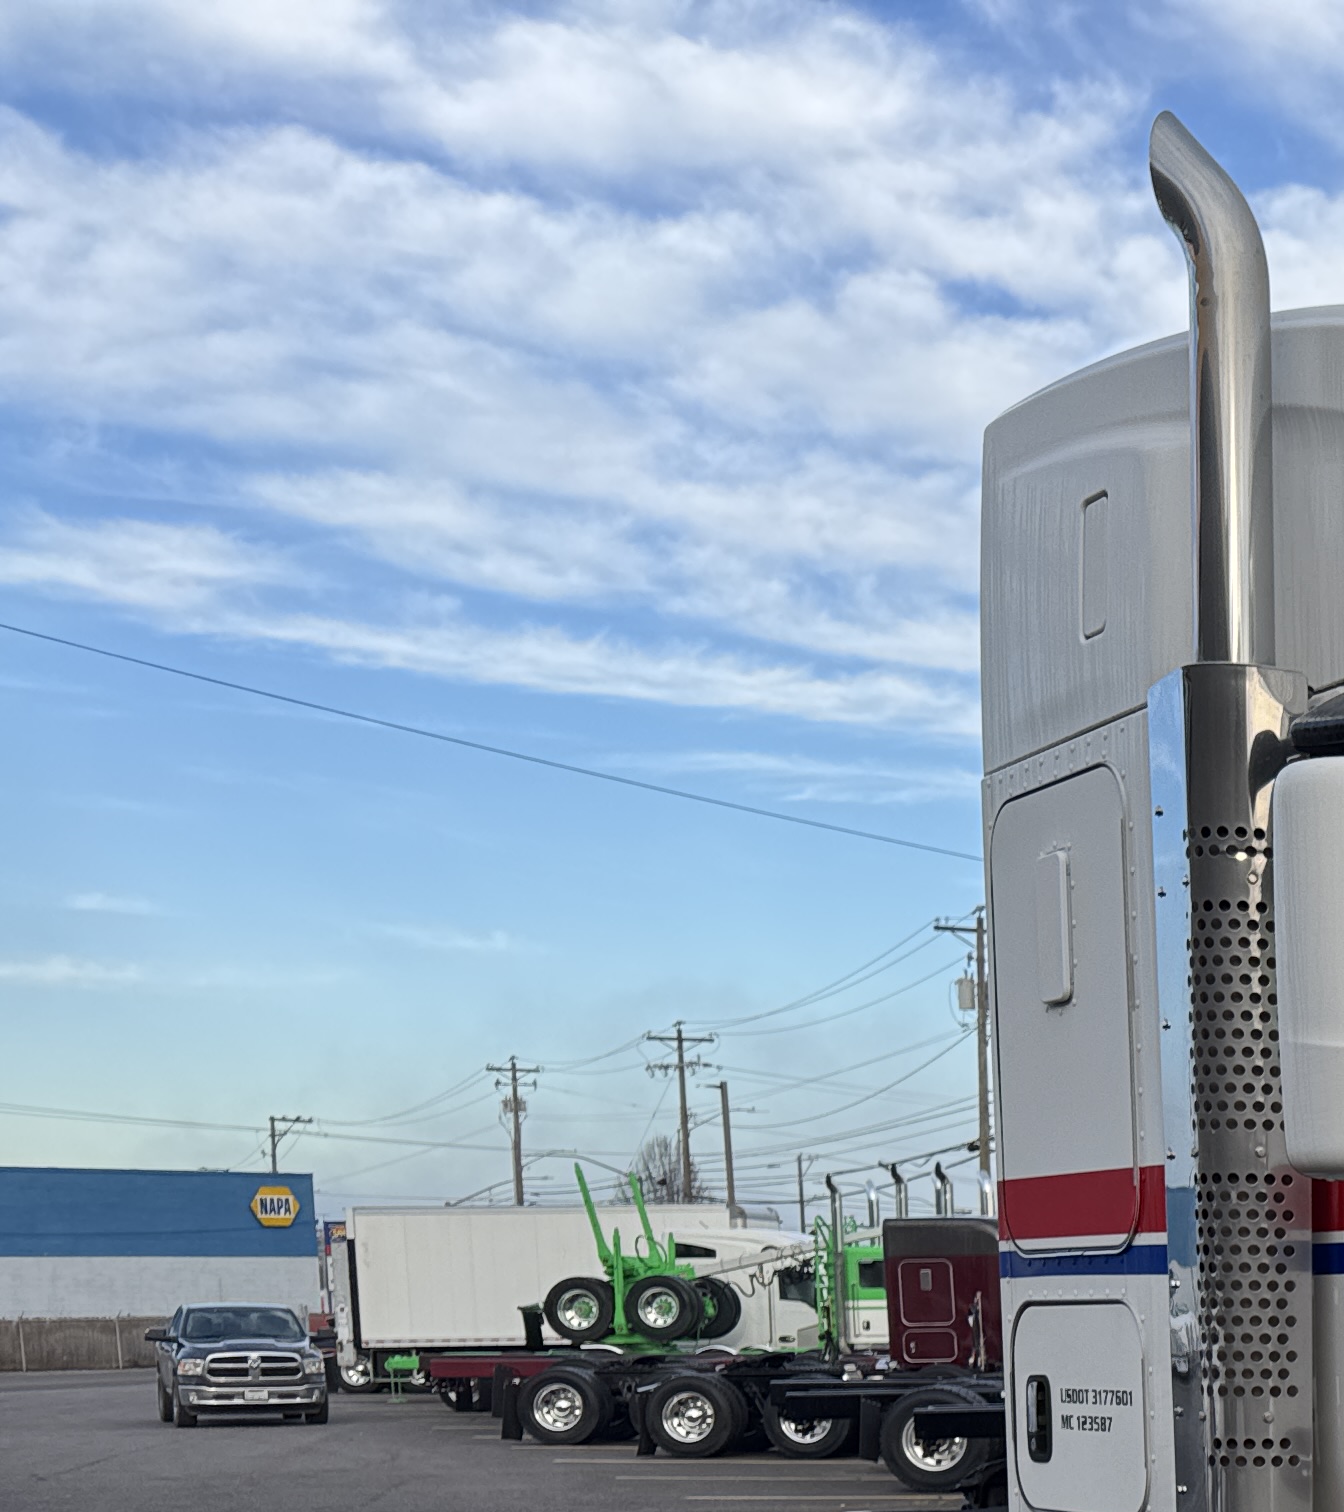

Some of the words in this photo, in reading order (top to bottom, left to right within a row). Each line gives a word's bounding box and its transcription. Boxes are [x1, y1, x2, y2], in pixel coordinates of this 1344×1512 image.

[260, 1198, 291, 1216] NAPA
[1060, 1387, 1090, 1405] USDOT
[1091, 1388, 1133, 1407] 3177601
[1061, 1413, 1075, 1431] MC
[1076, 1415, 1113, 1433] 123587
